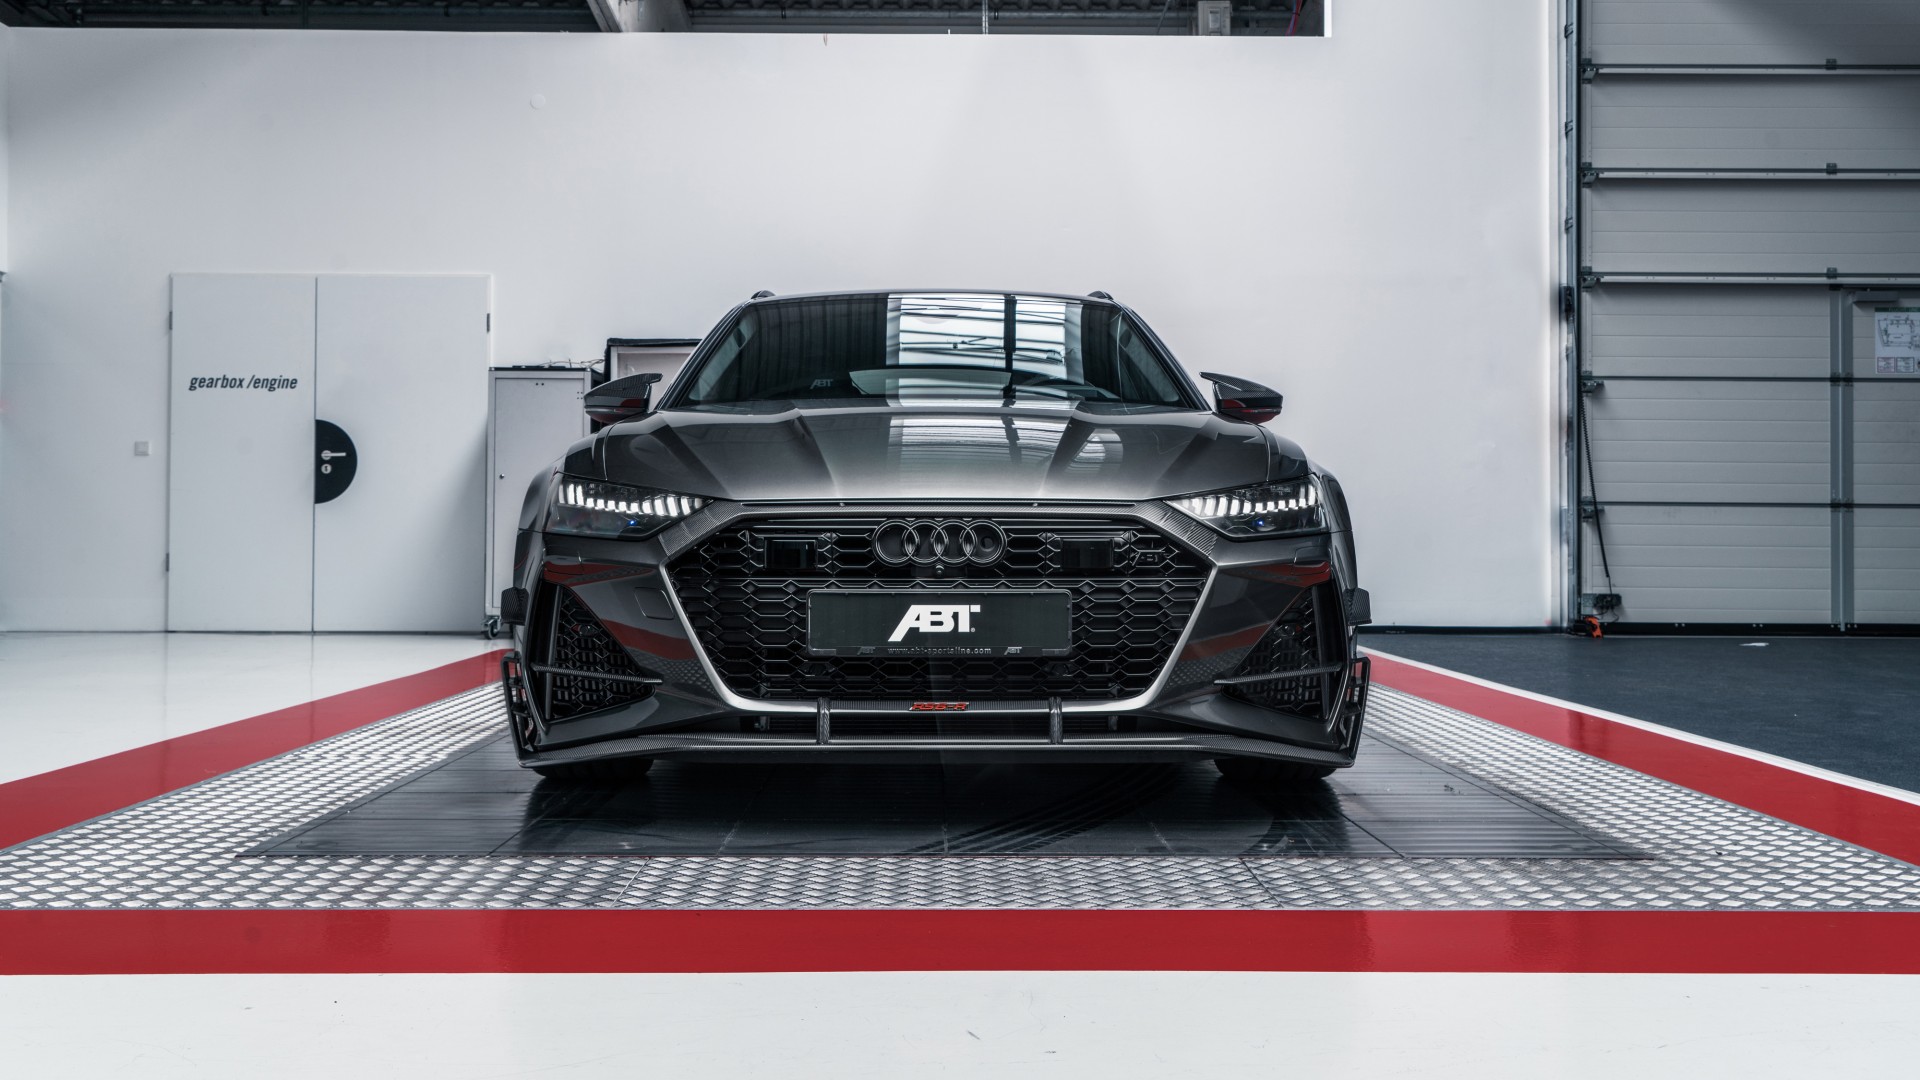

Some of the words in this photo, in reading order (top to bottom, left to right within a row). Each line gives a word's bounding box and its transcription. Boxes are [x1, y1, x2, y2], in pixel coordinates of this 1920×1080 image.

[188, 374, 245, 391] gearbox
[246, 374, 298, 392] /engine
[810, 379, 834, 389] ABT
[888, 605, 981, 642] ABT
[1004, 646, 1022, 656] ABT
